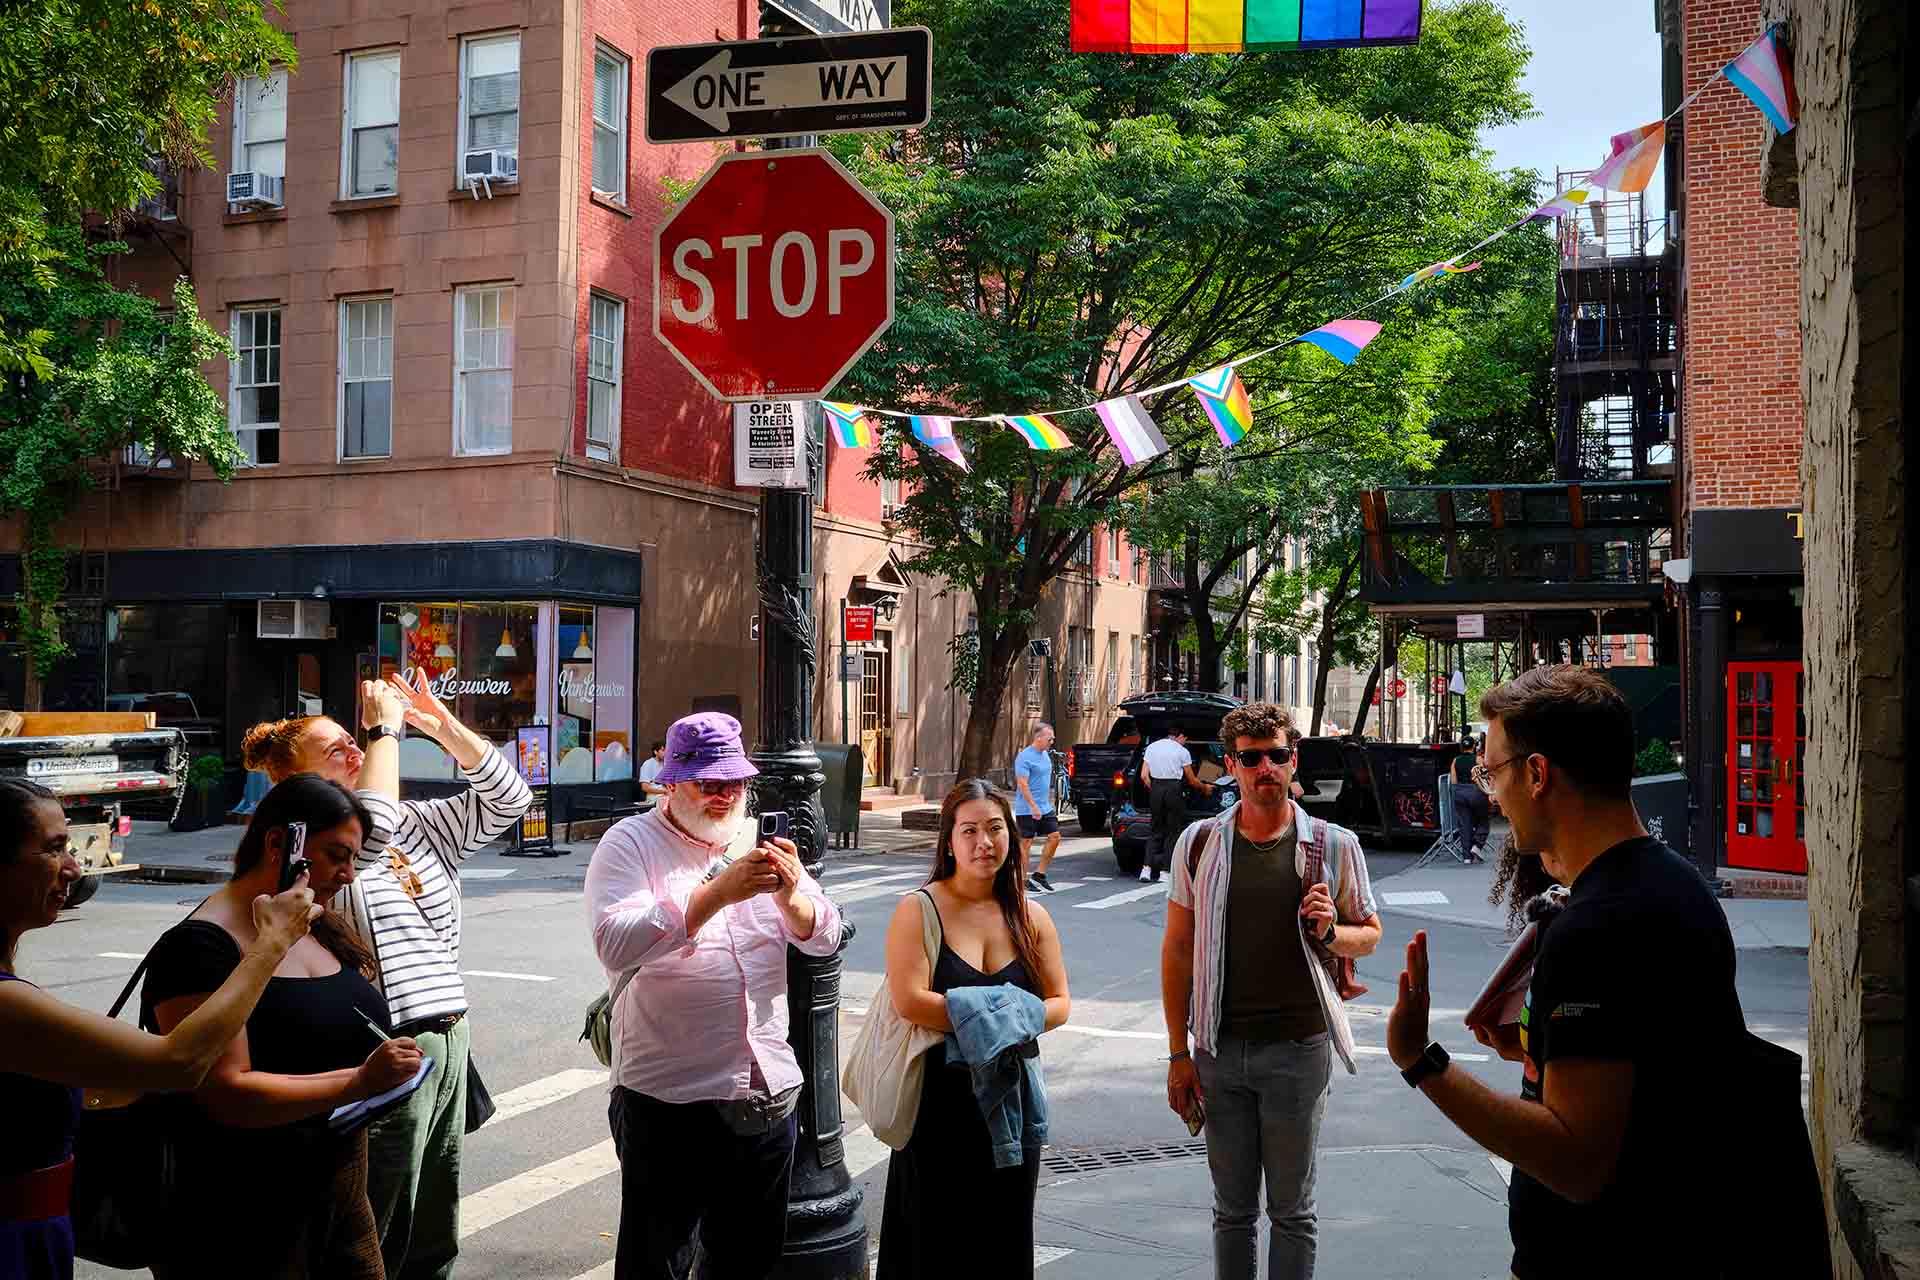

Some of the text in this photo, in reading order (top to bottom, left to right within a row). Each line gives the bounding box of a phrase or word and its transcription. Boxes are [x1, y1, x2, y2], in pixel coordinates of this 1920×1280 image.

[693, 61, 896, 110] ONE WAY
[671, 228, 875, 324] STOP
[750, 403, 792, 414] OPEN
[749, 415, 793, 426] STREETS
[1388, 684, 1405, 693] SOP
[46, 758, 113, 771] United Rentals
